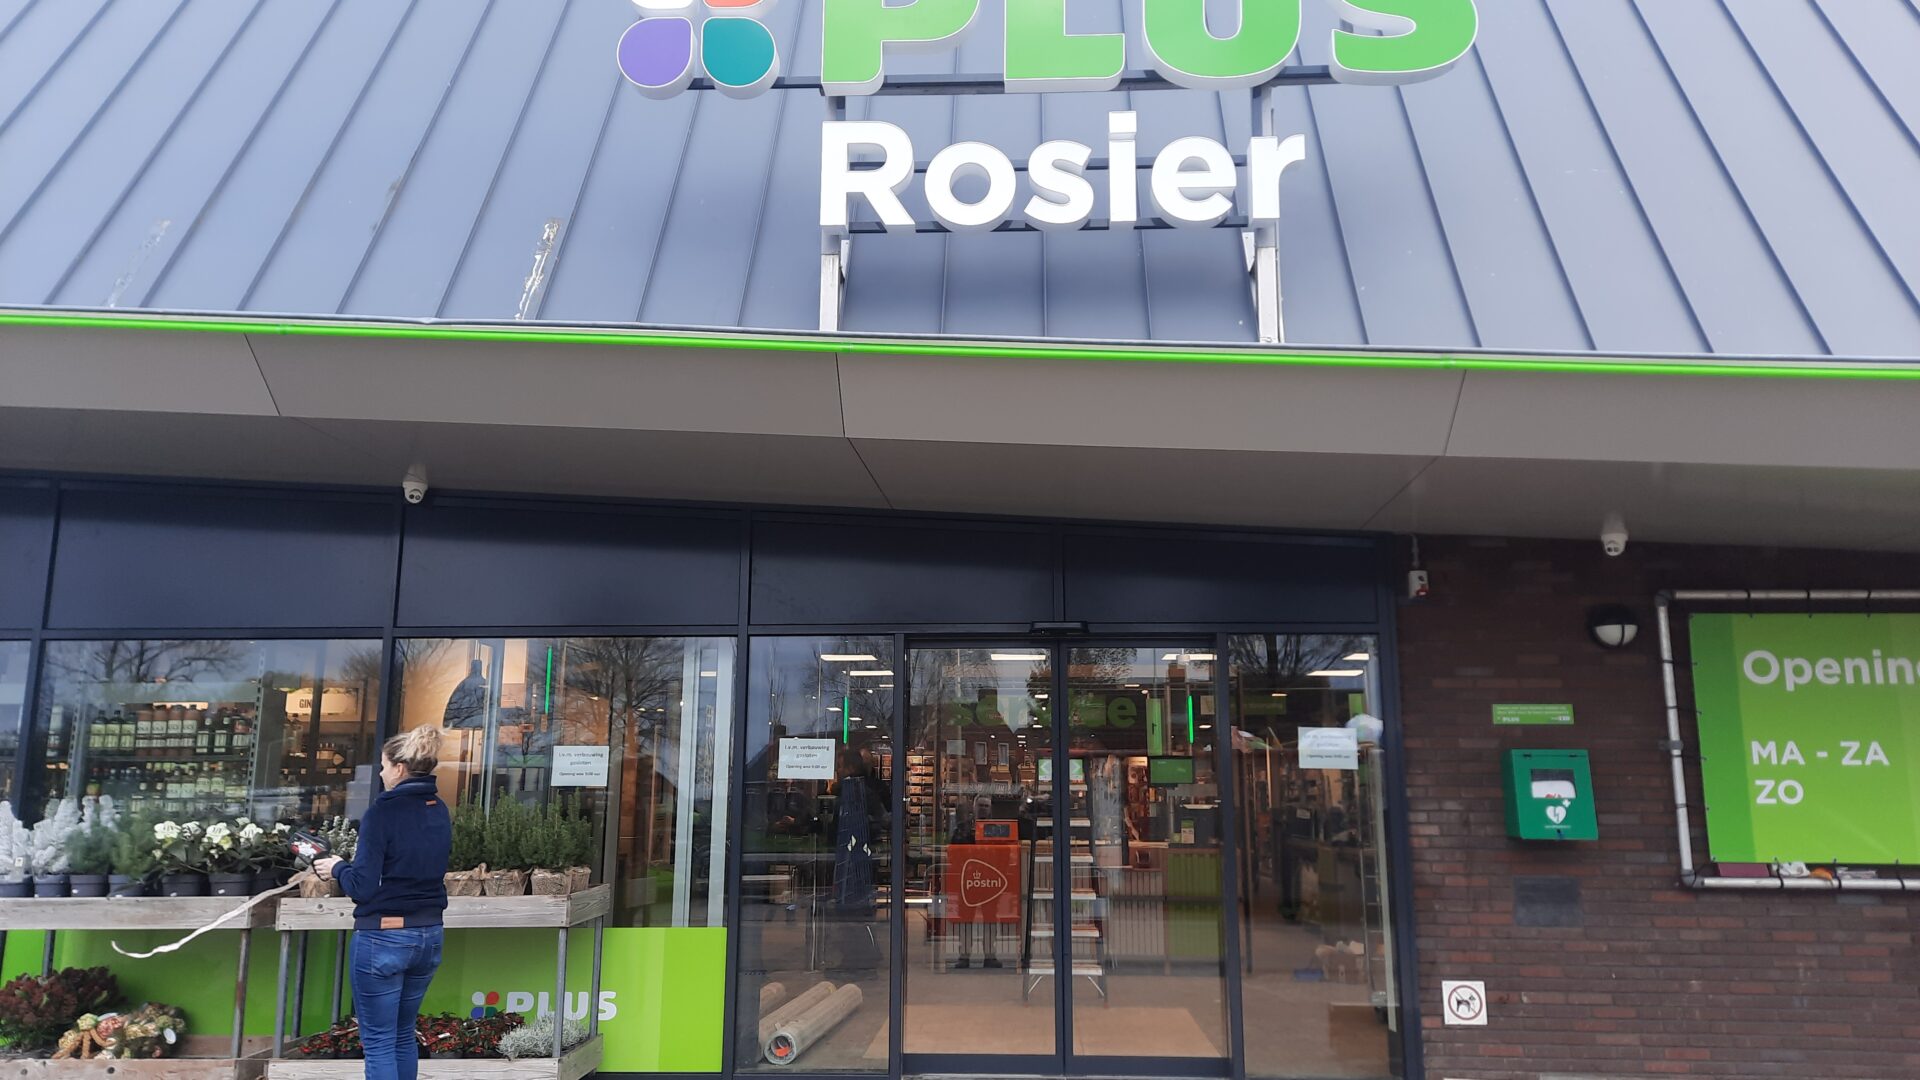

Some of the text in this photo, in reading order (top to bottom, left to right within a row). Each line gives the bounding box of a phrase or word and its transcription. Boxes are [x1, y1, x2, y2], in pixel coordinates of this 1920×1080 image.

[820, 111, 1306, 232] Rosier
[1743, 649, 1920, 691] Openin
[1751, 741, 1806, 765] MA
[1840, 741, 1890, 765] ZA
[1755, 779, 1804, 805] ZO
[966, 878, 1002, 890] postnl
[506, 991, 617, 1021] PLUS
